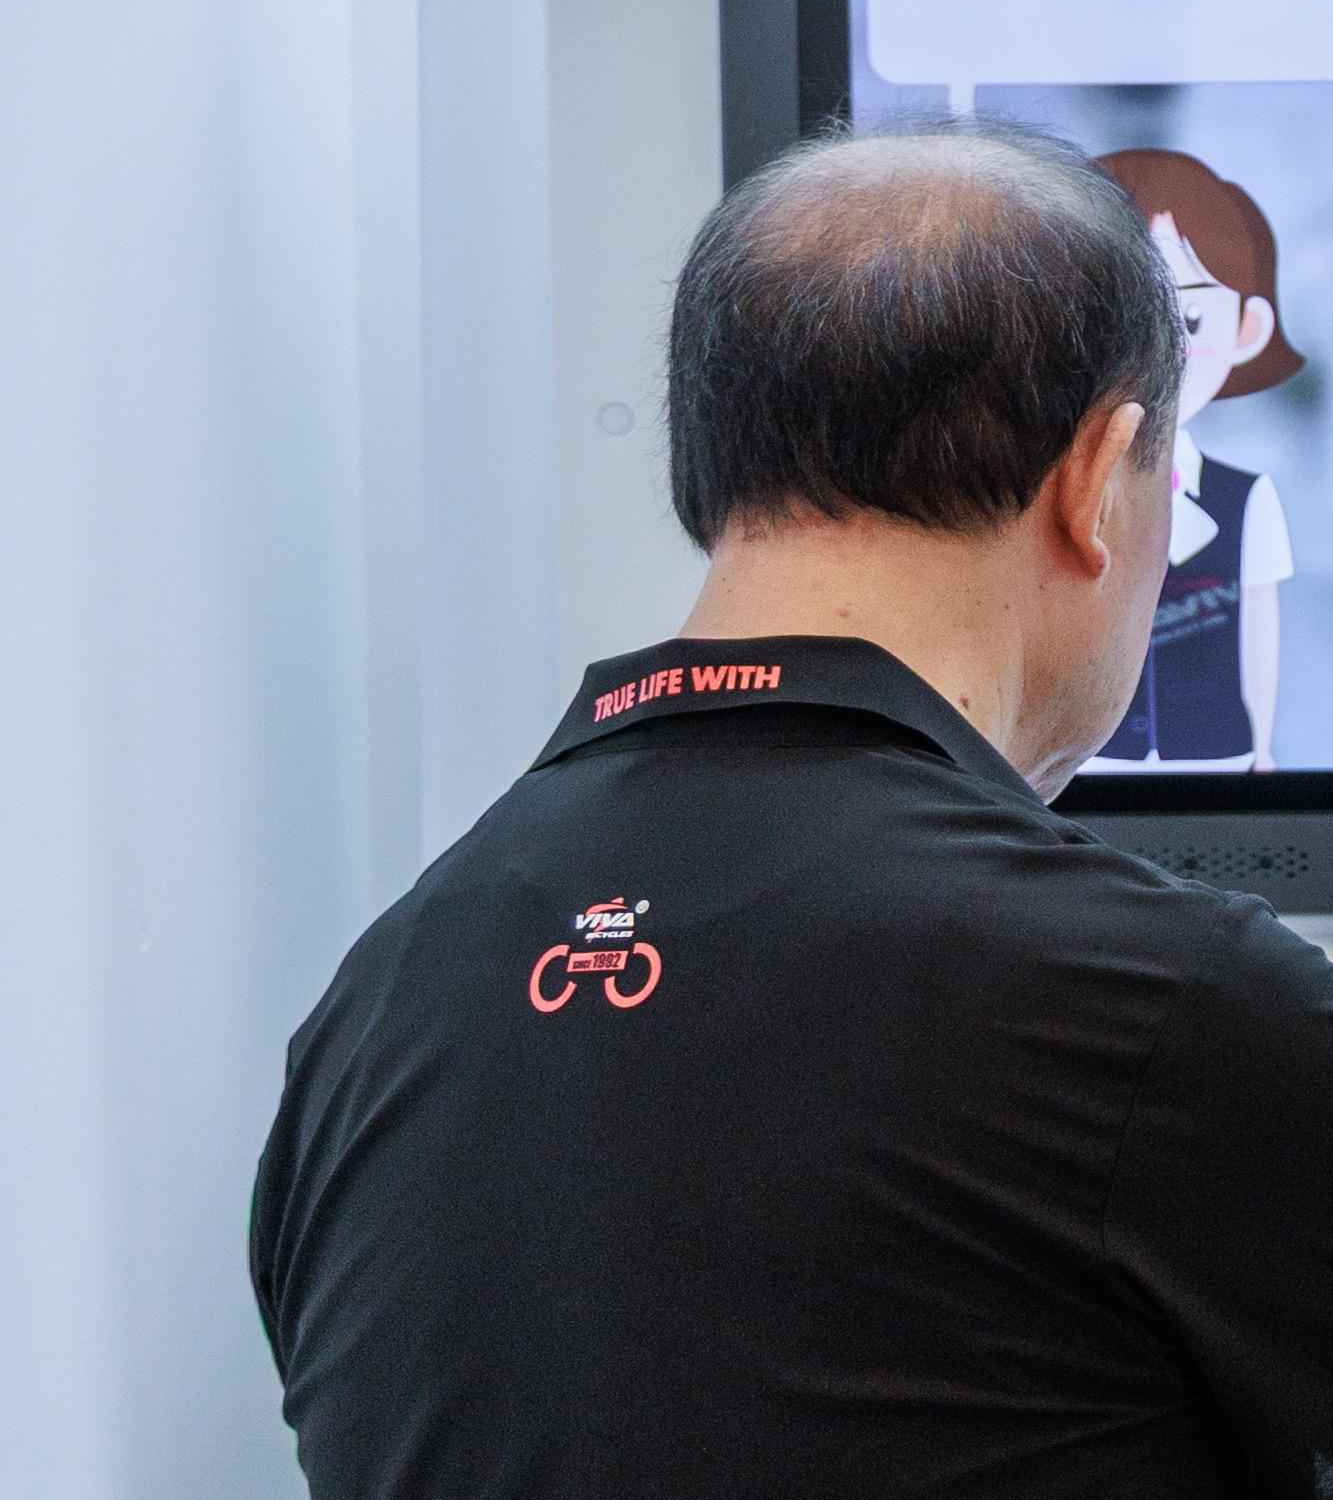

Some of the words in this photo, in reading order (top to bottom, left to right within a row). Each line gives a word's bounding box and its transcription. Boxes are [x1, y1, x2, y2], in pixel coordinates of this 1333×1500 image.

[593, 682, 637, 723] TRUE
[638, 668, 684, 703] LIFE
[691, 665, 782, 692] WITH
[575, 912, 635, 930] VIVA
